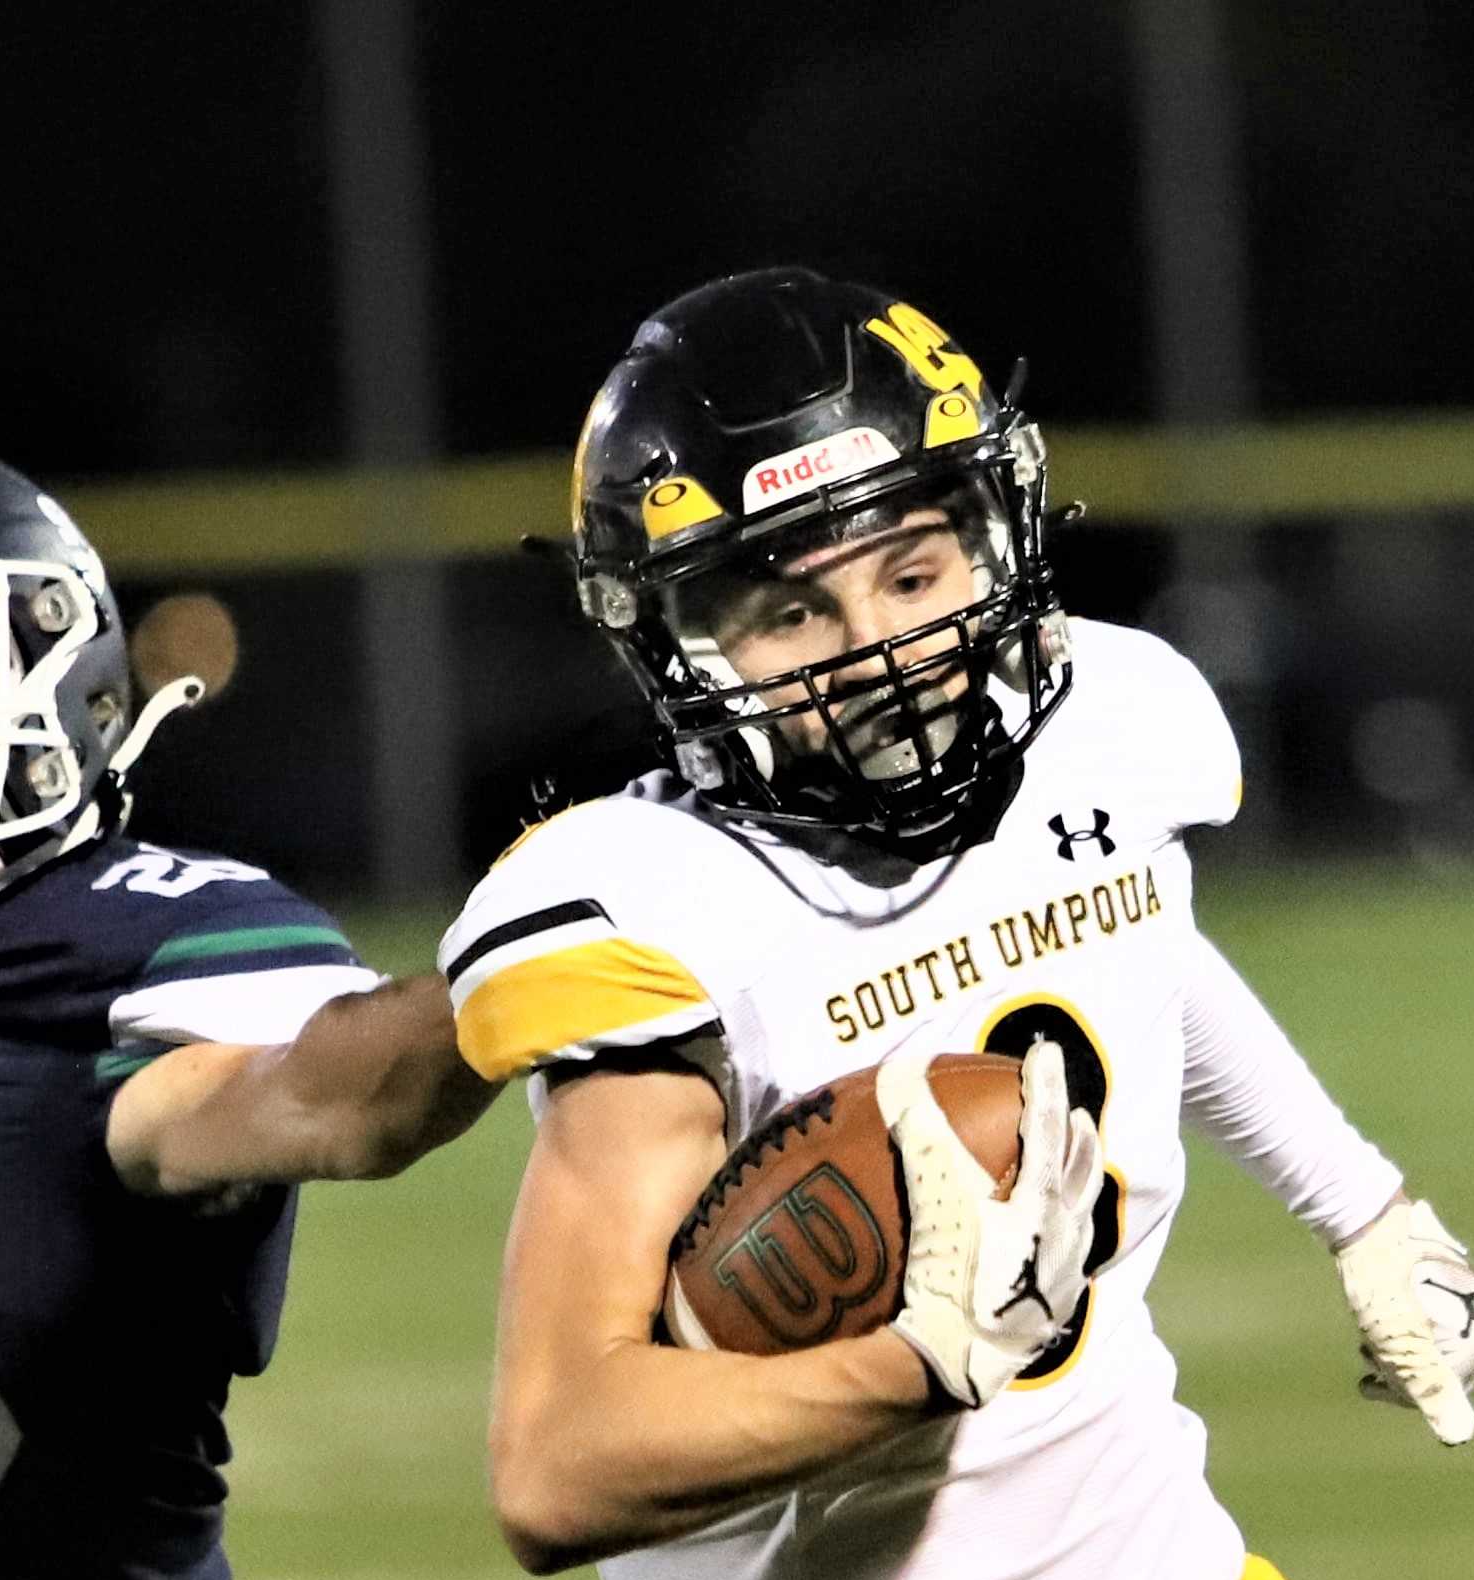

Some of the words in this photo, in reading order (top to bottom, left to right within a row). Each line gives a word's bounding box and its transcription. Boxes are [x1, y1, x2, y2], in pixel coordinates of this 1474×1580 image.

[755, 433, 876, 495] Riddll
[825, 936, 982, 1043] SOUTH
[988, 864, 1163, 969] UMPQUA
